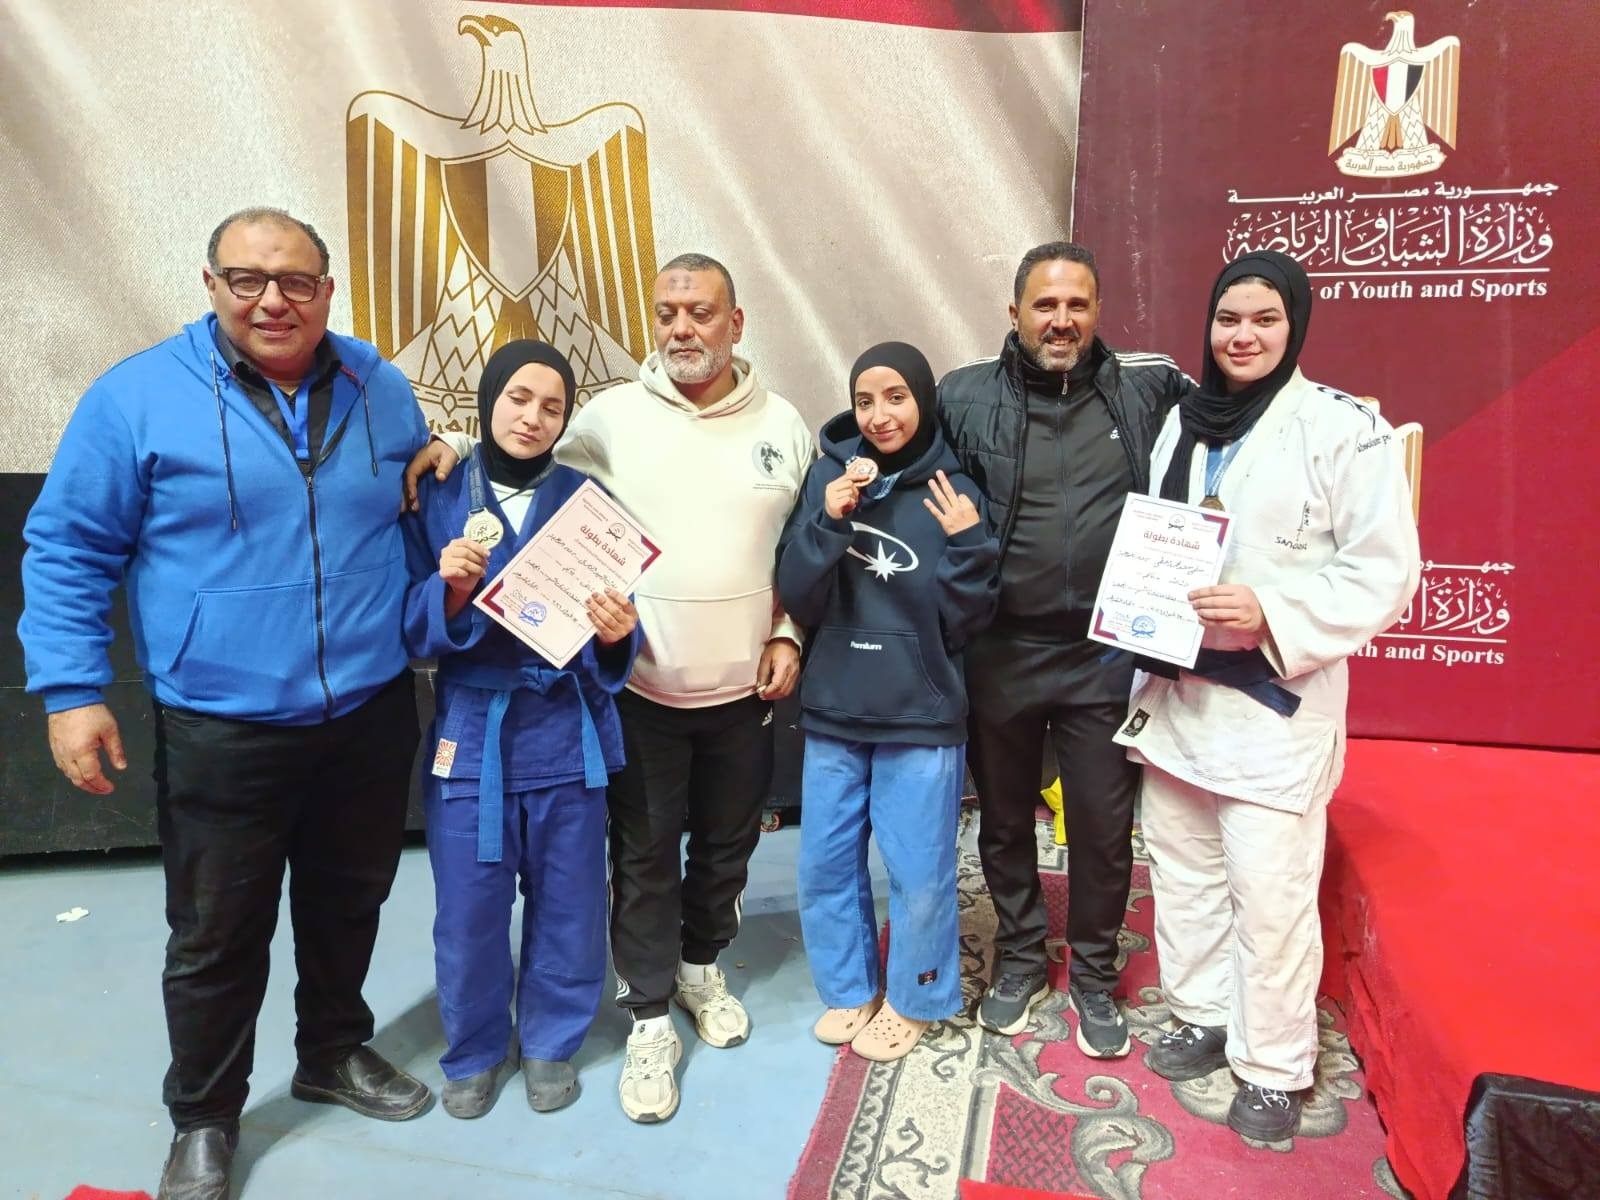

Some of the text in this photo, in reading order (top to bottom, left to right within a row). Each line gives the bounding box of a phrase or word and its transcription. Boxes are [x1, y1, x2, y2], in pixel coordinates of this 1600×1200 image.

[1345, 154, 1435, 174] جمهورية مصر العربية
[1227, 181, 1559, 205] جمهورية مصر العربية
[1319, 278, 1547, 302] of Youth and Sports
[580, 524, 602, 547] بطولة
[1143, 529, 1200, 550] شهادة بطولة
[601, 542, 626, 566] شهادة
[1385, 644, 1426, 661] and
[1432, 644, 1505, 666] Sports
